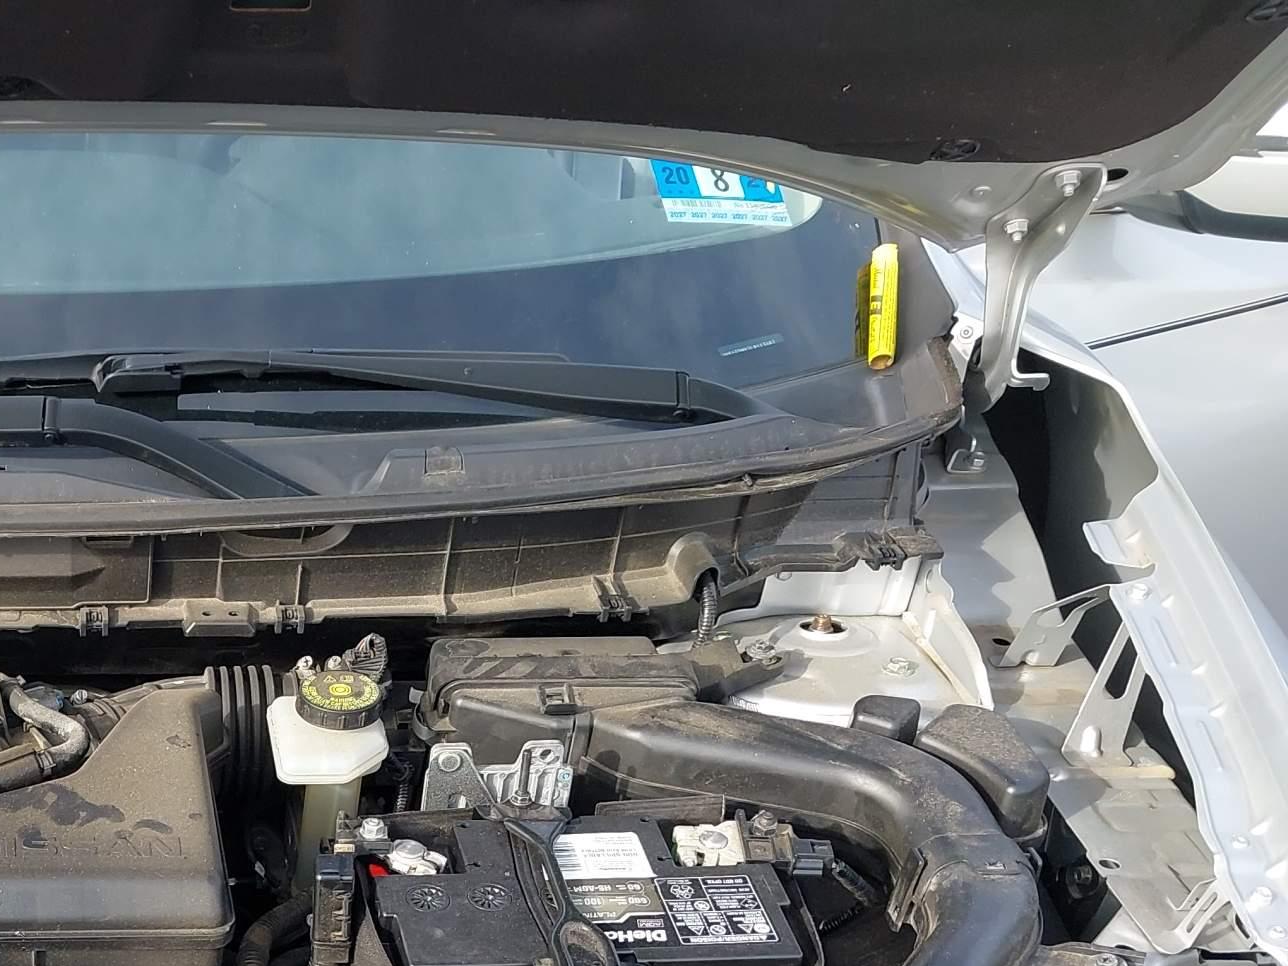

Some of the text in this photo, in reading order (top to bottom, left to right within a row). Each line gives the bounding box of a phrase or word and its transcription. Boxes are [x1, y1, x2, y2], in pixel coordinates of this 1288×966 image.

[662, 166, 690, 185] 20
[711, 168, 730, 192] 8
[582, 911, 617, 919] PLATIN
[602, 929, 668, 943] DieHa
